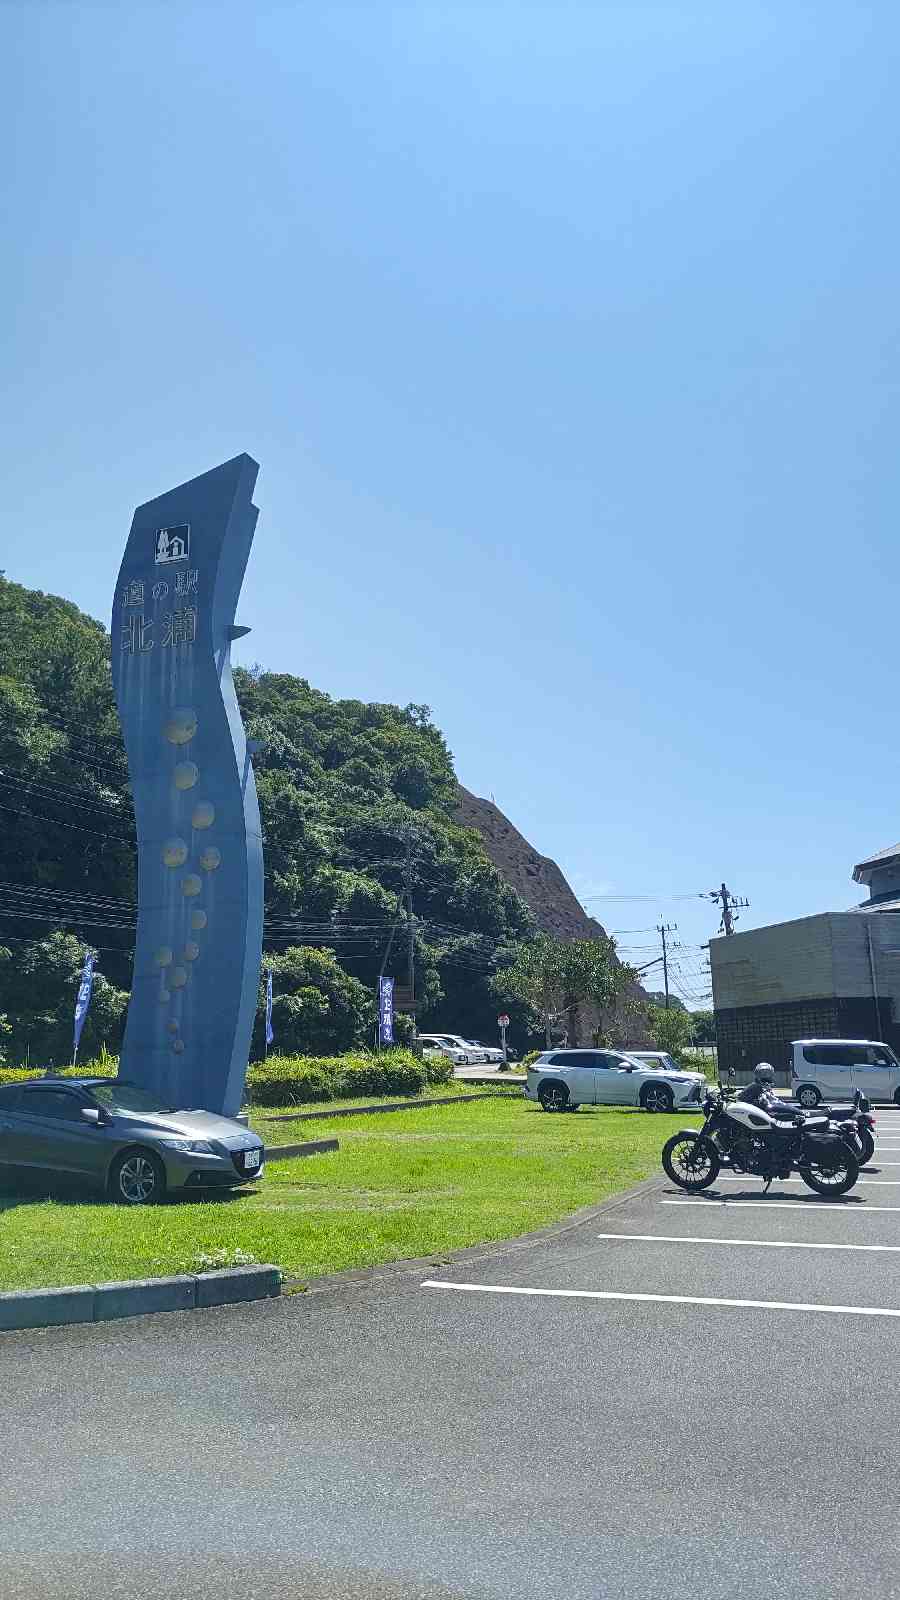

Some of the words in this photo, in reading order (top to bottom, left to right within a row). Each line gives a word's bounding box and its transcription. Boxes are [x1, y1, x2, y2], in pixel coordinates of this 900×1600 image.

[121, 569, 200, 608] 道の駅
[120, 606, 197, 655] 北浦
